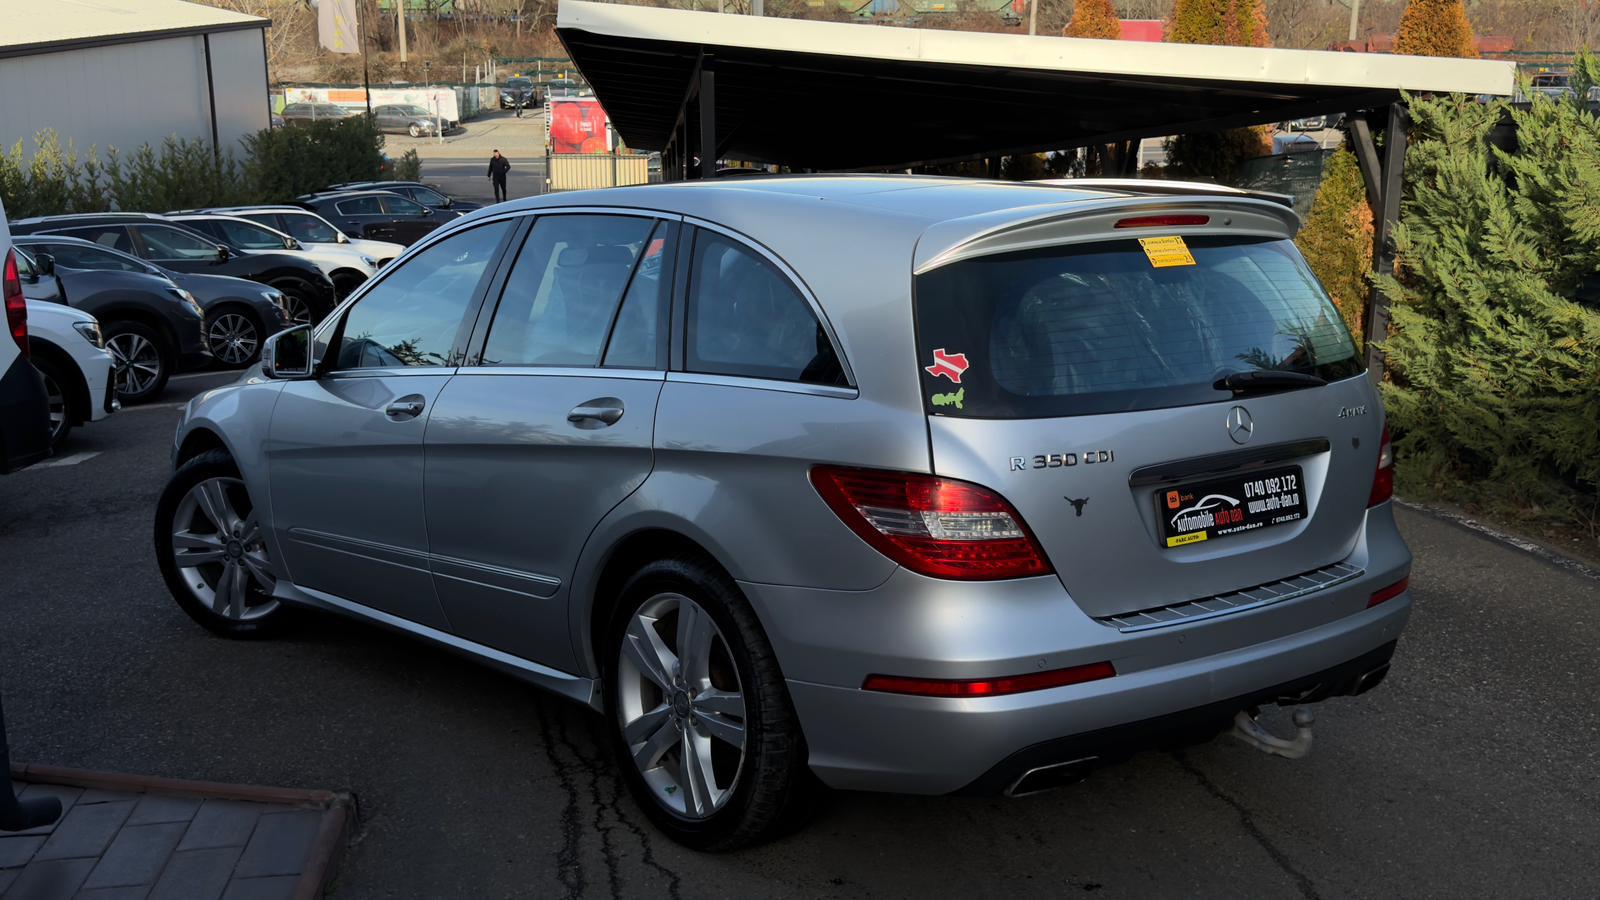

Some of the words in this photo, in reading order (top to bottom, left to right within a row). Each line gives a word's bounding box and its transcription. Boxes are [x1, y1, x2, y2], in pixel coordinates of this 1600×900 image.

[1010, 456, 1026, 471] R
[1033, 453, 1078, 469] 350
[1083, 450, 1114, 464] CDI
[1244, 480, 1265, 498] 0740
[1265, 478, 1281, 494] 092
[1281, 475, 1297, 491] 172
[1178, 509, 1215, 532] Automobile
[1217, 521, 1263, 535] www.auto-dan.ro
[1175, 536, 1187, 544] PARC
